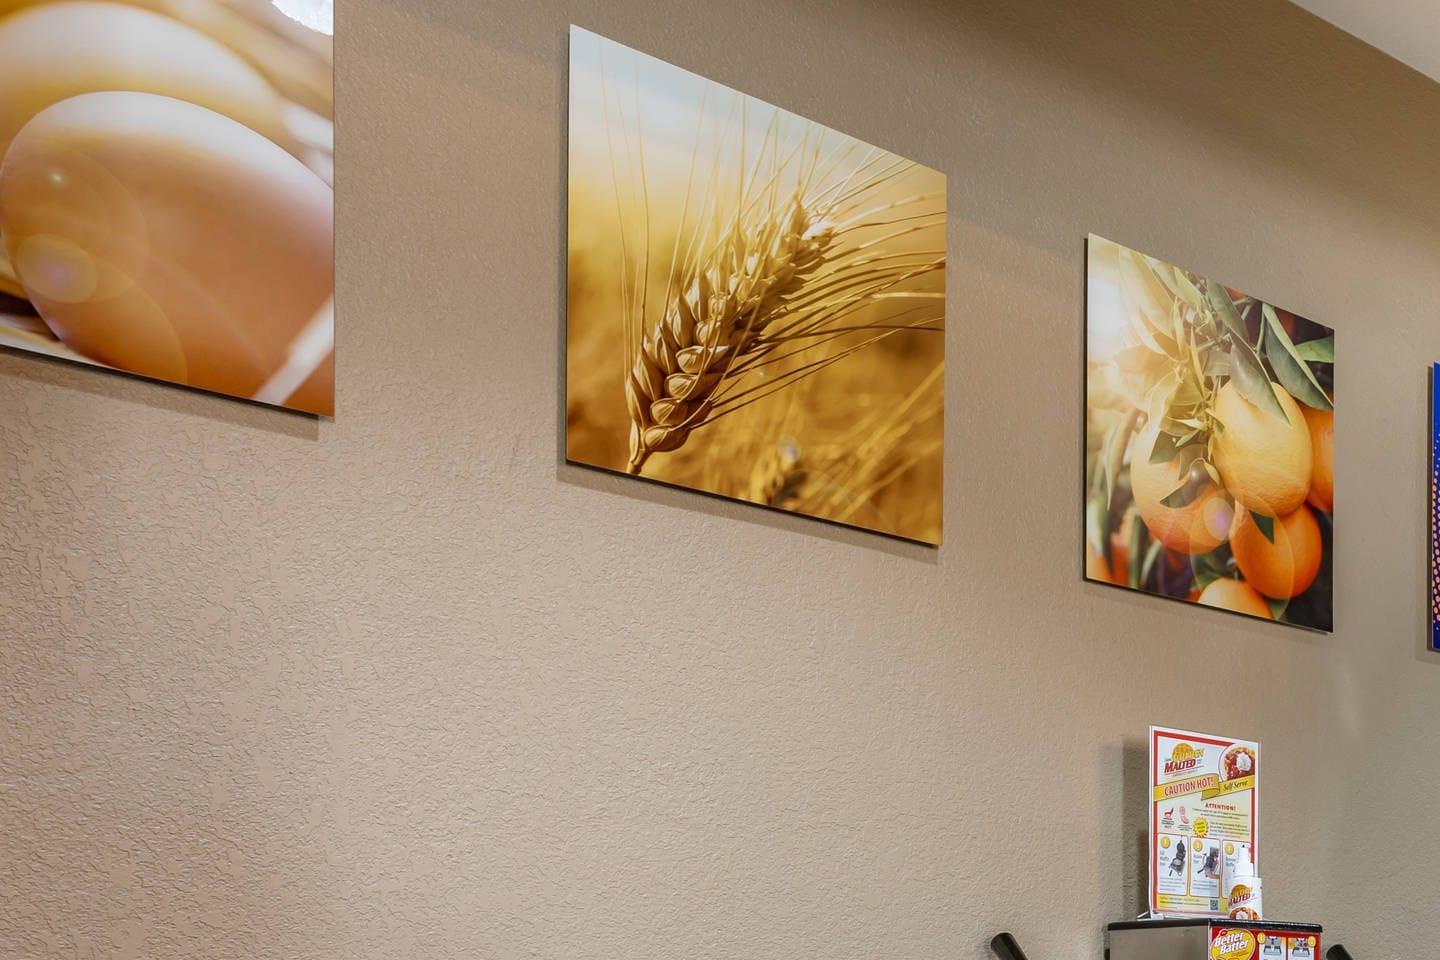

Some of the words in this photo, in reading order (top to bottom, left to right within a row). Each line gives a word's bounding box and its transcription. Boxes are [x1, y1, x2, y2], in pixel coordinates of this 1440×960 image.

[1164, 758, 1196, 773] MALTED
[1164, 780, 1196, 796] CAUTION
[1197, 776, 1214, 789] HOT!
[1223, 781, 1234, 791] Self
[1234, 779, 1249, 788] Serve
[1205, 802, 1236, 812] ATTENTION!
[1214, 931, 1244, 947] Better
[1220, 939, 1249, 955] Batter
